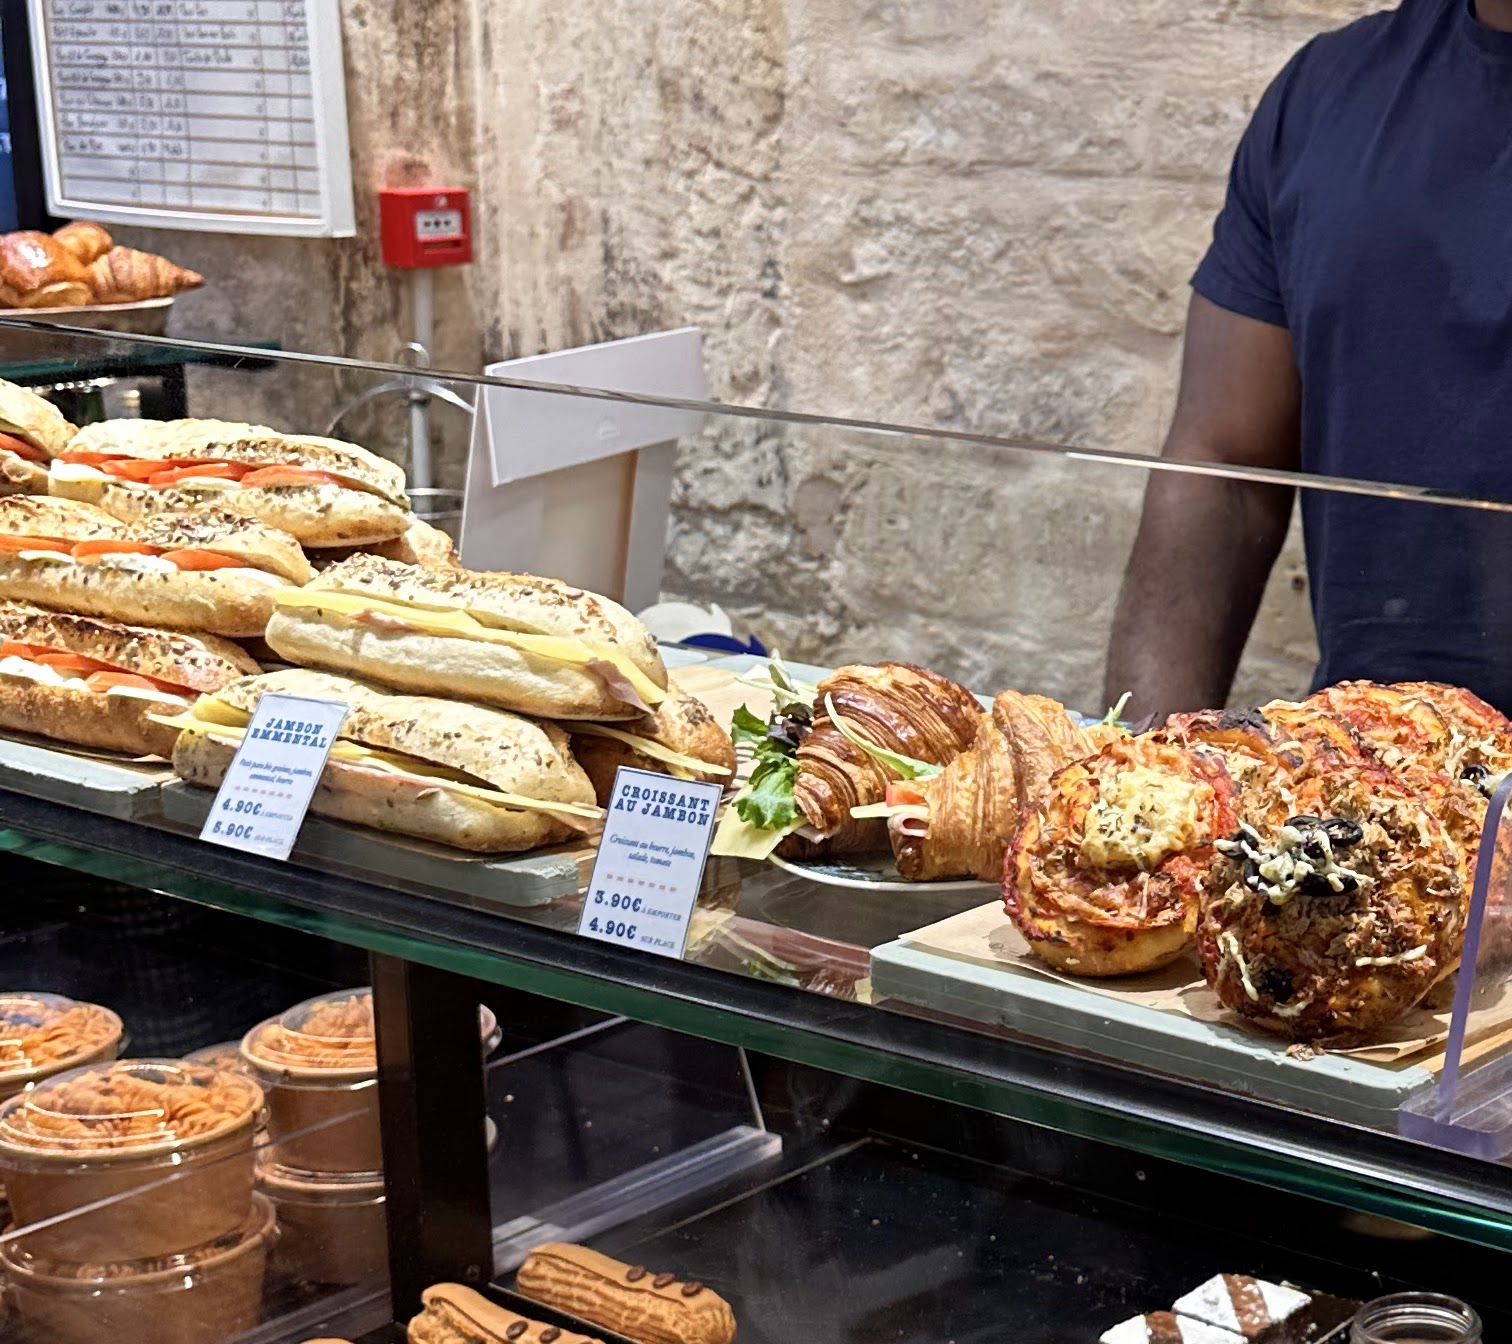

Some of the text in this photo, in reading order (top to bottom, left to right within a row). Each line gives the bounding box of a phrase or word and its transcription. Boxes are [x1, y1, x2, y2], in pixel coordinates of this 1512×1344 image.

[266, 718, 323, 734] JAMBON
[251, 728, 327, 748] EMMENTAL
[222, 798, 262, 815] 4.90€
[622, 784, 710, 811] CROISSANT
[614, 798, 710, 826] AU JAMBON
[594, 890, 642, 912] 3.90€
[589, 917, 636, 939] 4.90€
